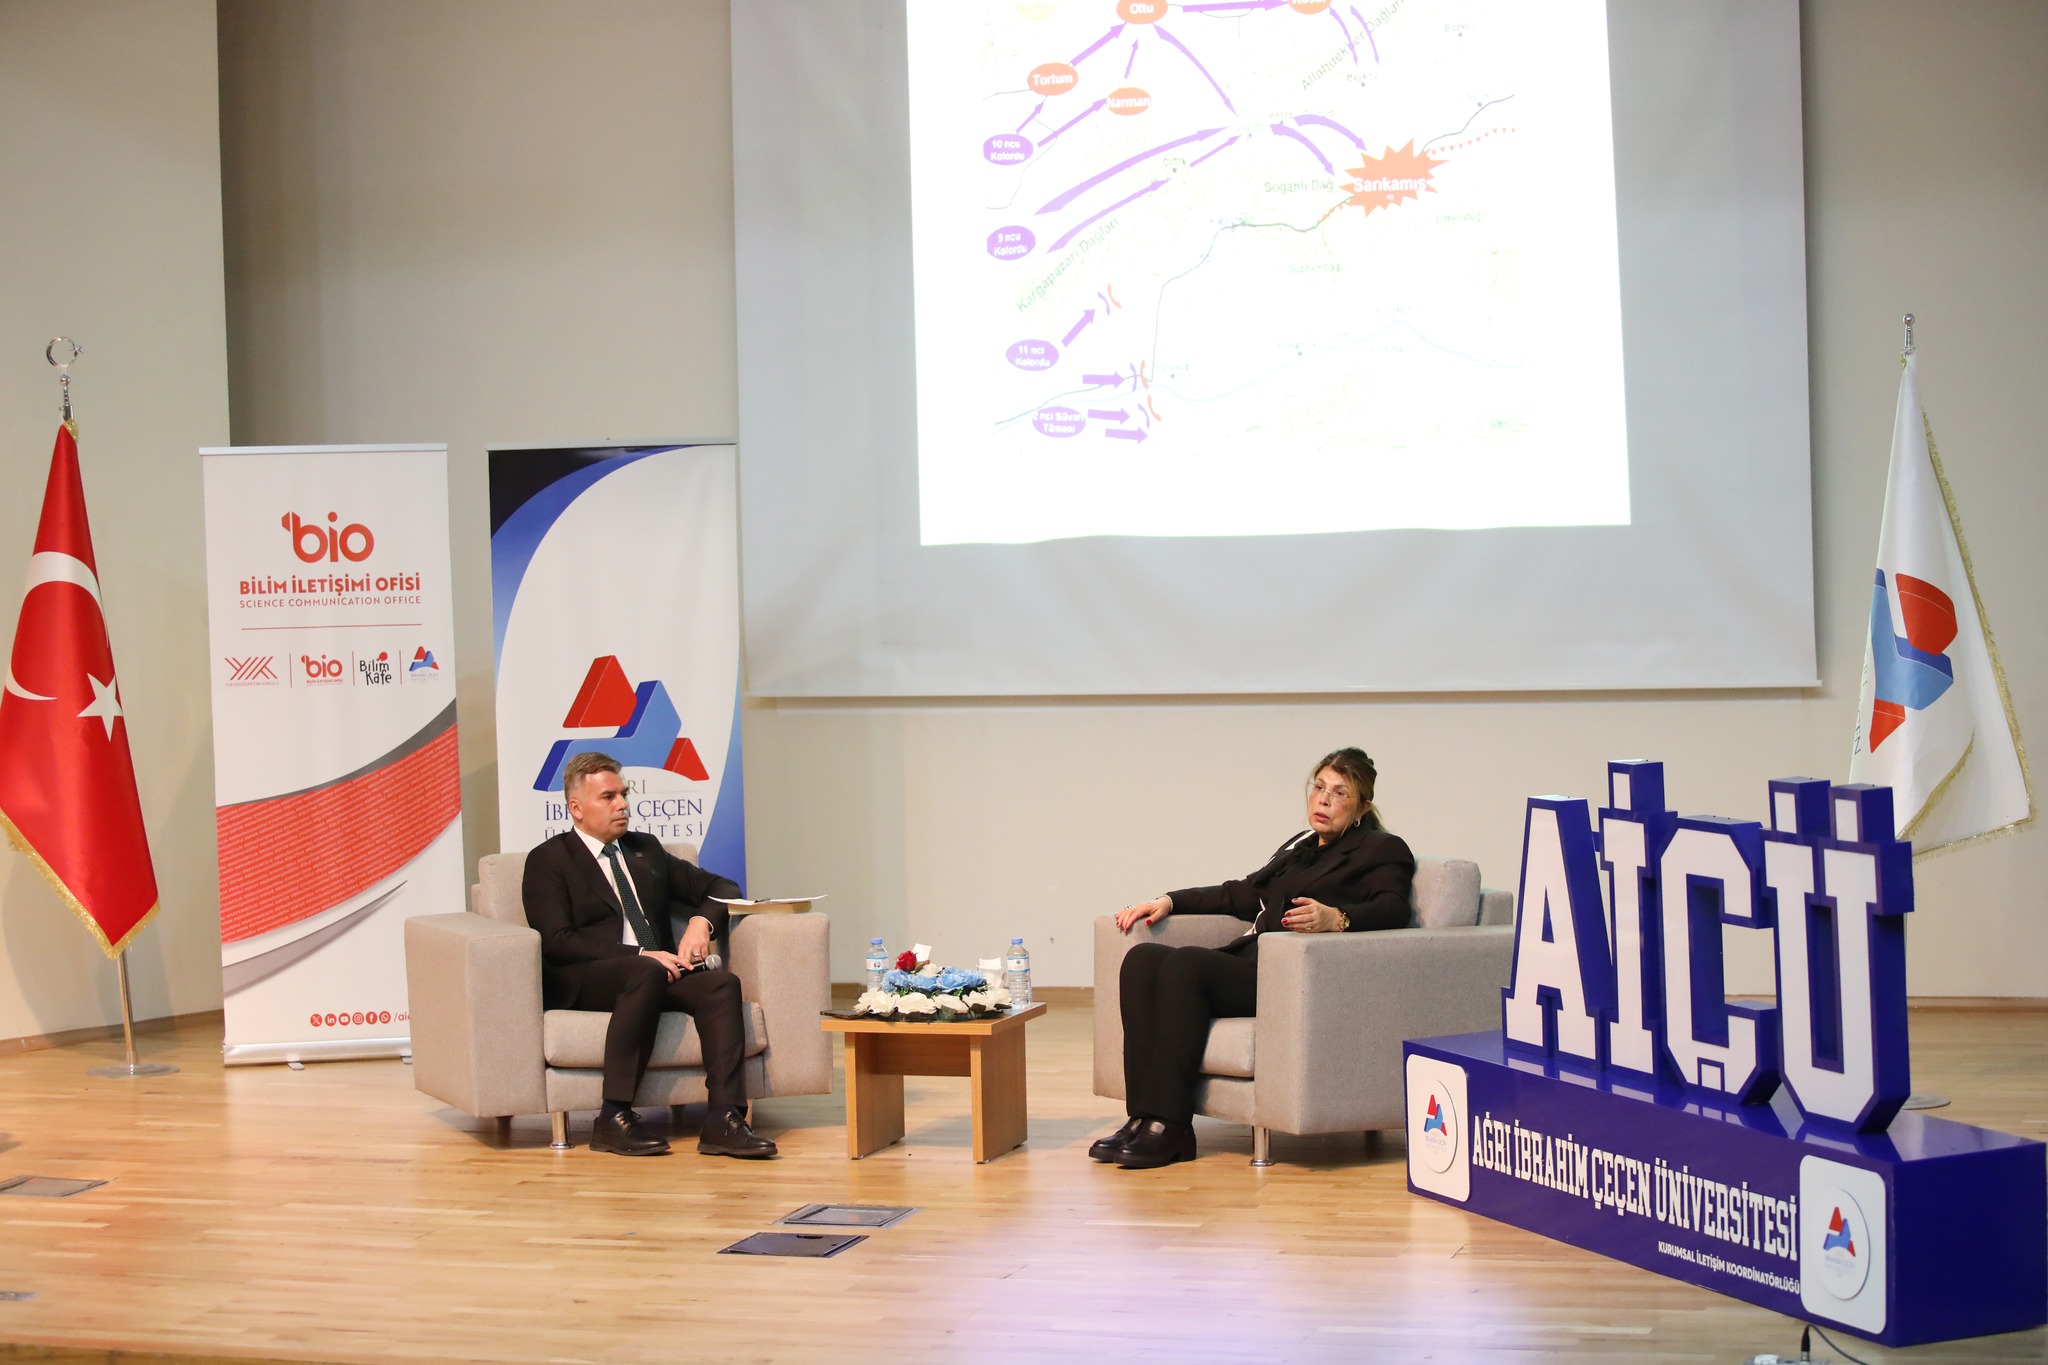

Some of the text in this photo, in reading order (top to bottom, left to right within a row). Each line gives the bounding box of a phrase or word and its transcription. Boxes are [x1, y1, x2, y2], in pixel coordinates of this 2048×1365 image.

[1129, 3, 1154, 14] Oltu
[1302, 31, 1364, 91] Allahueker
[1033, 73, 1073, 85] Tortum
[1106, 96, 1151, 108] Narman
[1353, 177, 1427, 194] Sarıkamış
[282, 511, 374, 563] bio
[239, 572, 420, 596] BİLİM İLETİŞİMİ OFİSİ
[239, 595, 421, 608] SCIENCE COMMUNICATION OFFICE
[301, 654, 343, 678] bio
[359, 656, 390, 672] Bilim
[366, 669, 392, 686] Kafe
[637, 799, 703, 821] ÇEÇEN
[1502, 760, 1905, 1132] AİÇÜ
[1472, 1111, 1798, 1262] AĞRI İBRAHİM ÇEÇEN ÜNİVERSİTESİ
[1658, 1241, 1696, 1263] KURUMSAL
[1696, 1249, 1725, 1272] İLETİŞİM
[1726, 1262, 1800, 1295] KOORDİNATÖRLÜĞÜ
